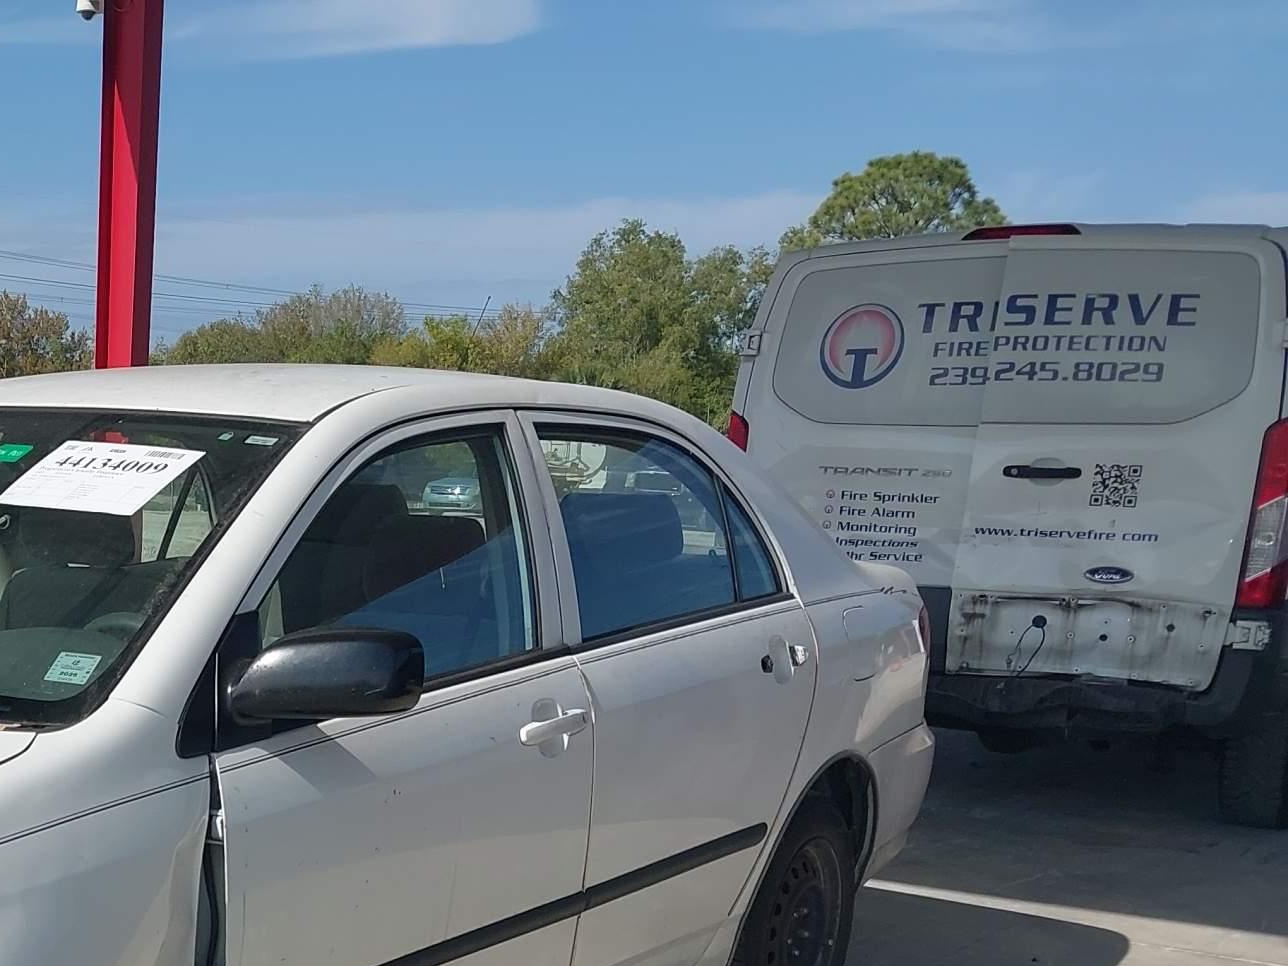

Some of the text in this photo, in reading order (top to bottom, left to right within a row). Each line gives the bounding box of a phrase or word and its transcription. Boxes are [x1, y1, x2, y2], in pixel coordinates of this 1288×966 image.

[918, 293, 1201, 334] TRISERVE
[932, 335, 1168, 358] FIRE PROTECTION
[928, 361, 1165, 386] 239.245.8029
[55, 455, 169, 475] 44134009
[819, 466, 919, 477] TRANSIT
[840, 490, 941, 504] Fire Sprinkler
[839, 505, 916, 519] Fire Alarm
[836, 521, 917, 537] Monitoring
[974, 527, 1159, 542] www.triservefirecom
[835, 536, 919, 548] Inspections
[868, 551, 923, 563] Service
